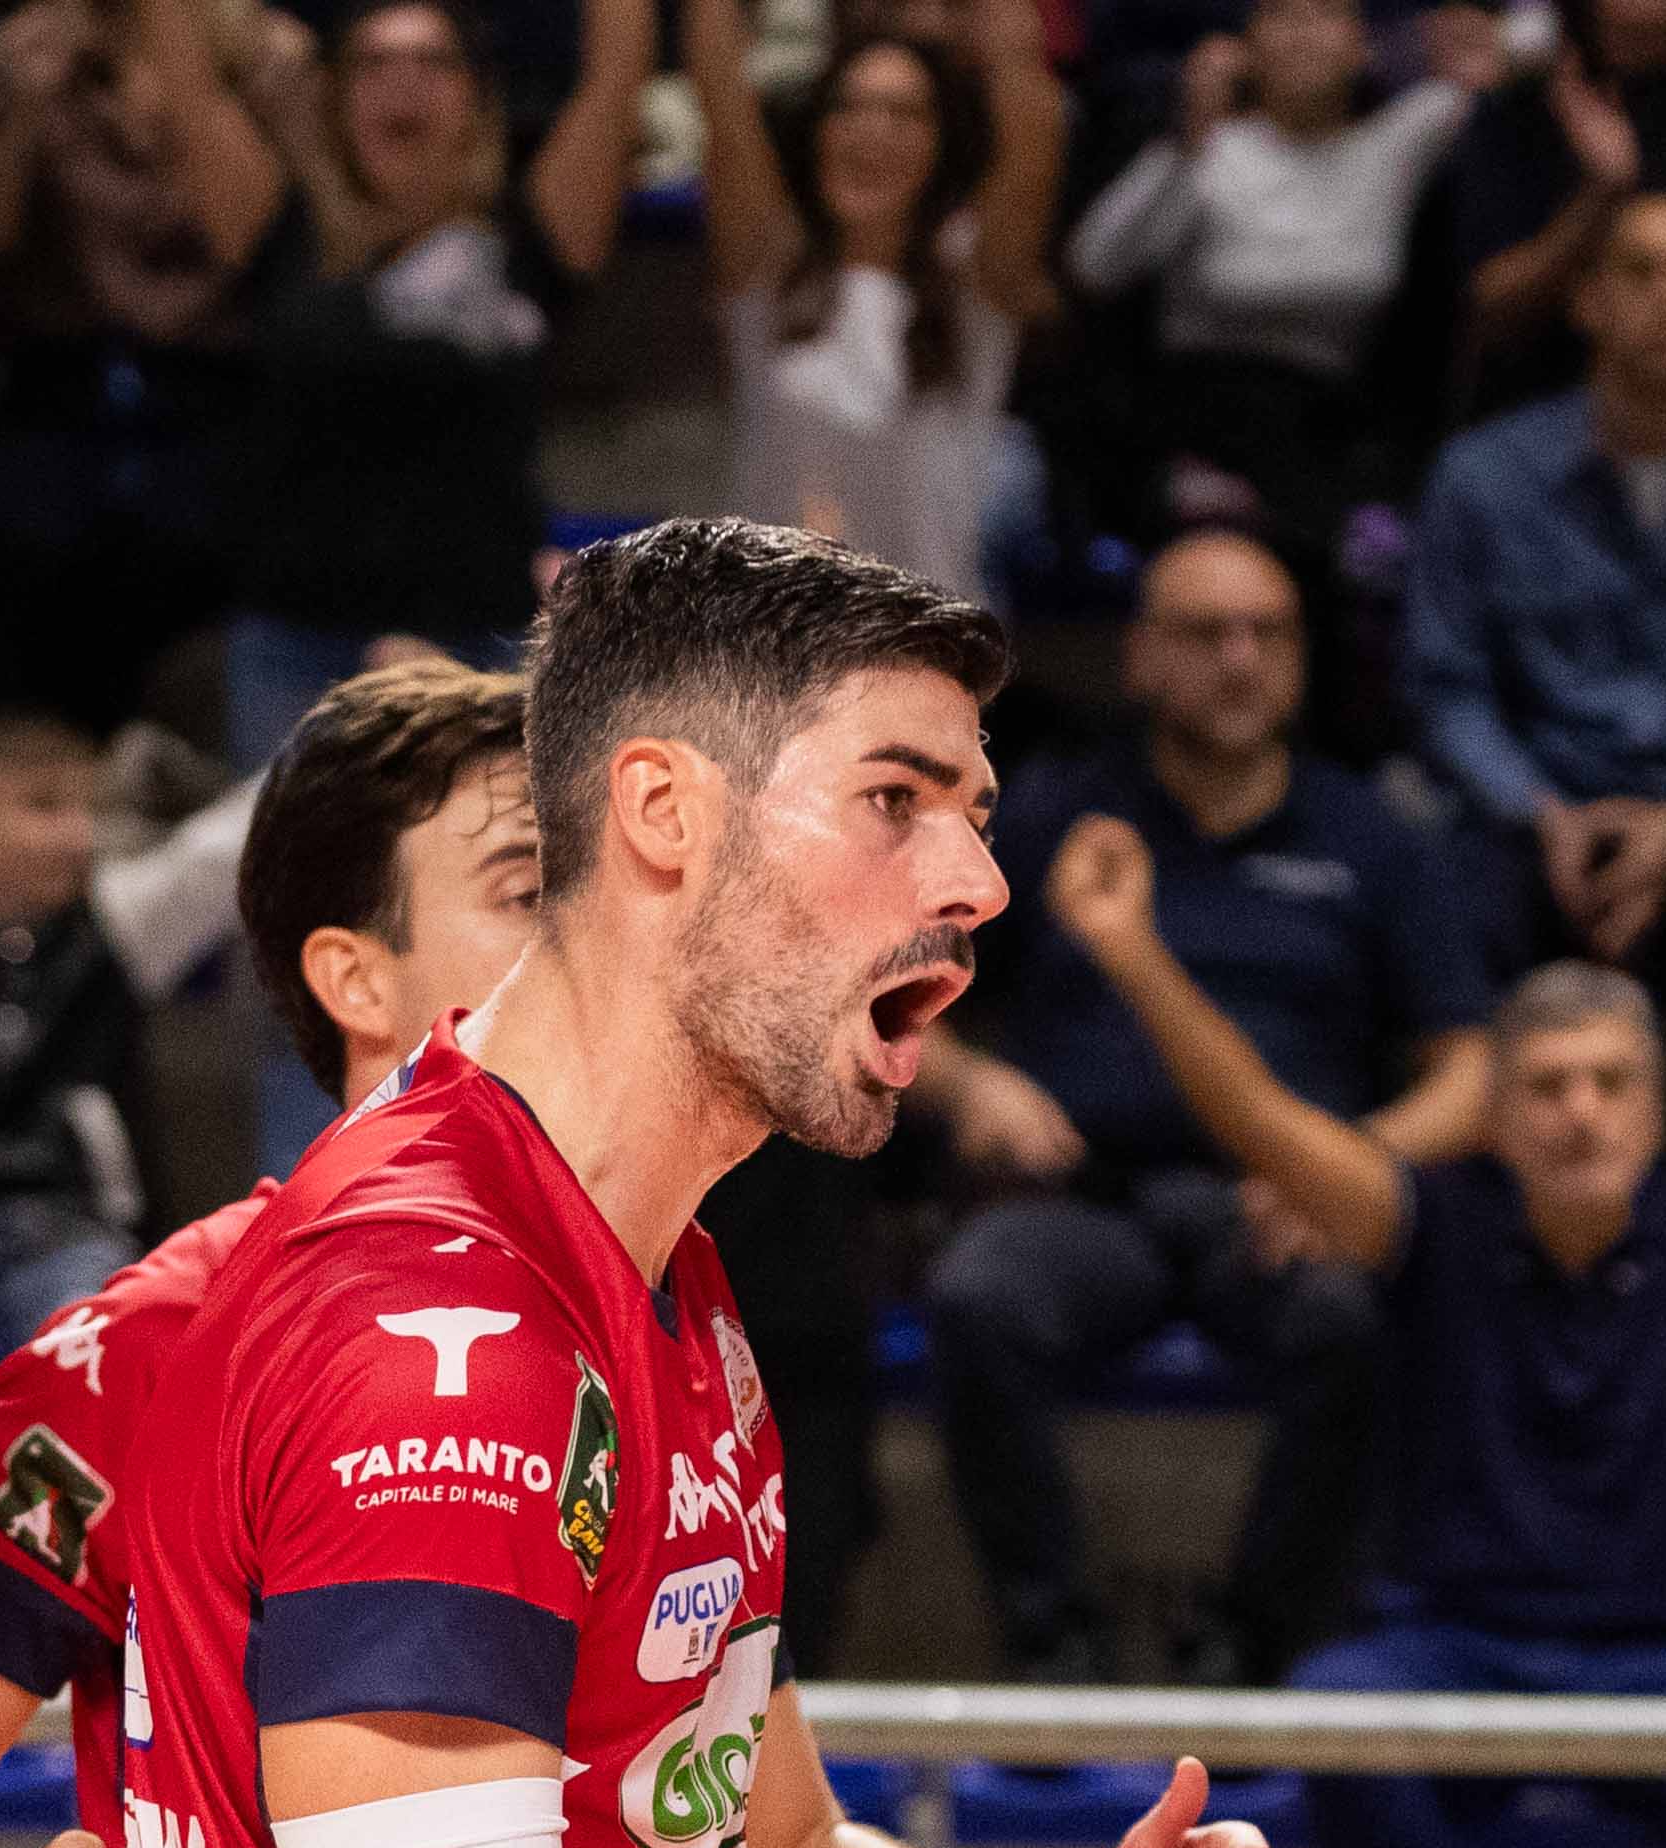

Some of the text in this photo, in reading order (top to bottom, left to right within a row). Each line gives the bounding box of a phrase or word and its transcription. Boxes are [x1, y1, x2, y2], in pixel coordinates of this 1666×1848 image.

[331, 1436, 553, 1493] TARANTO
[354, 1484, 519, 1515] CAPITALE DI MARE
[654, 1572, 740, 1630] PUGLIA
